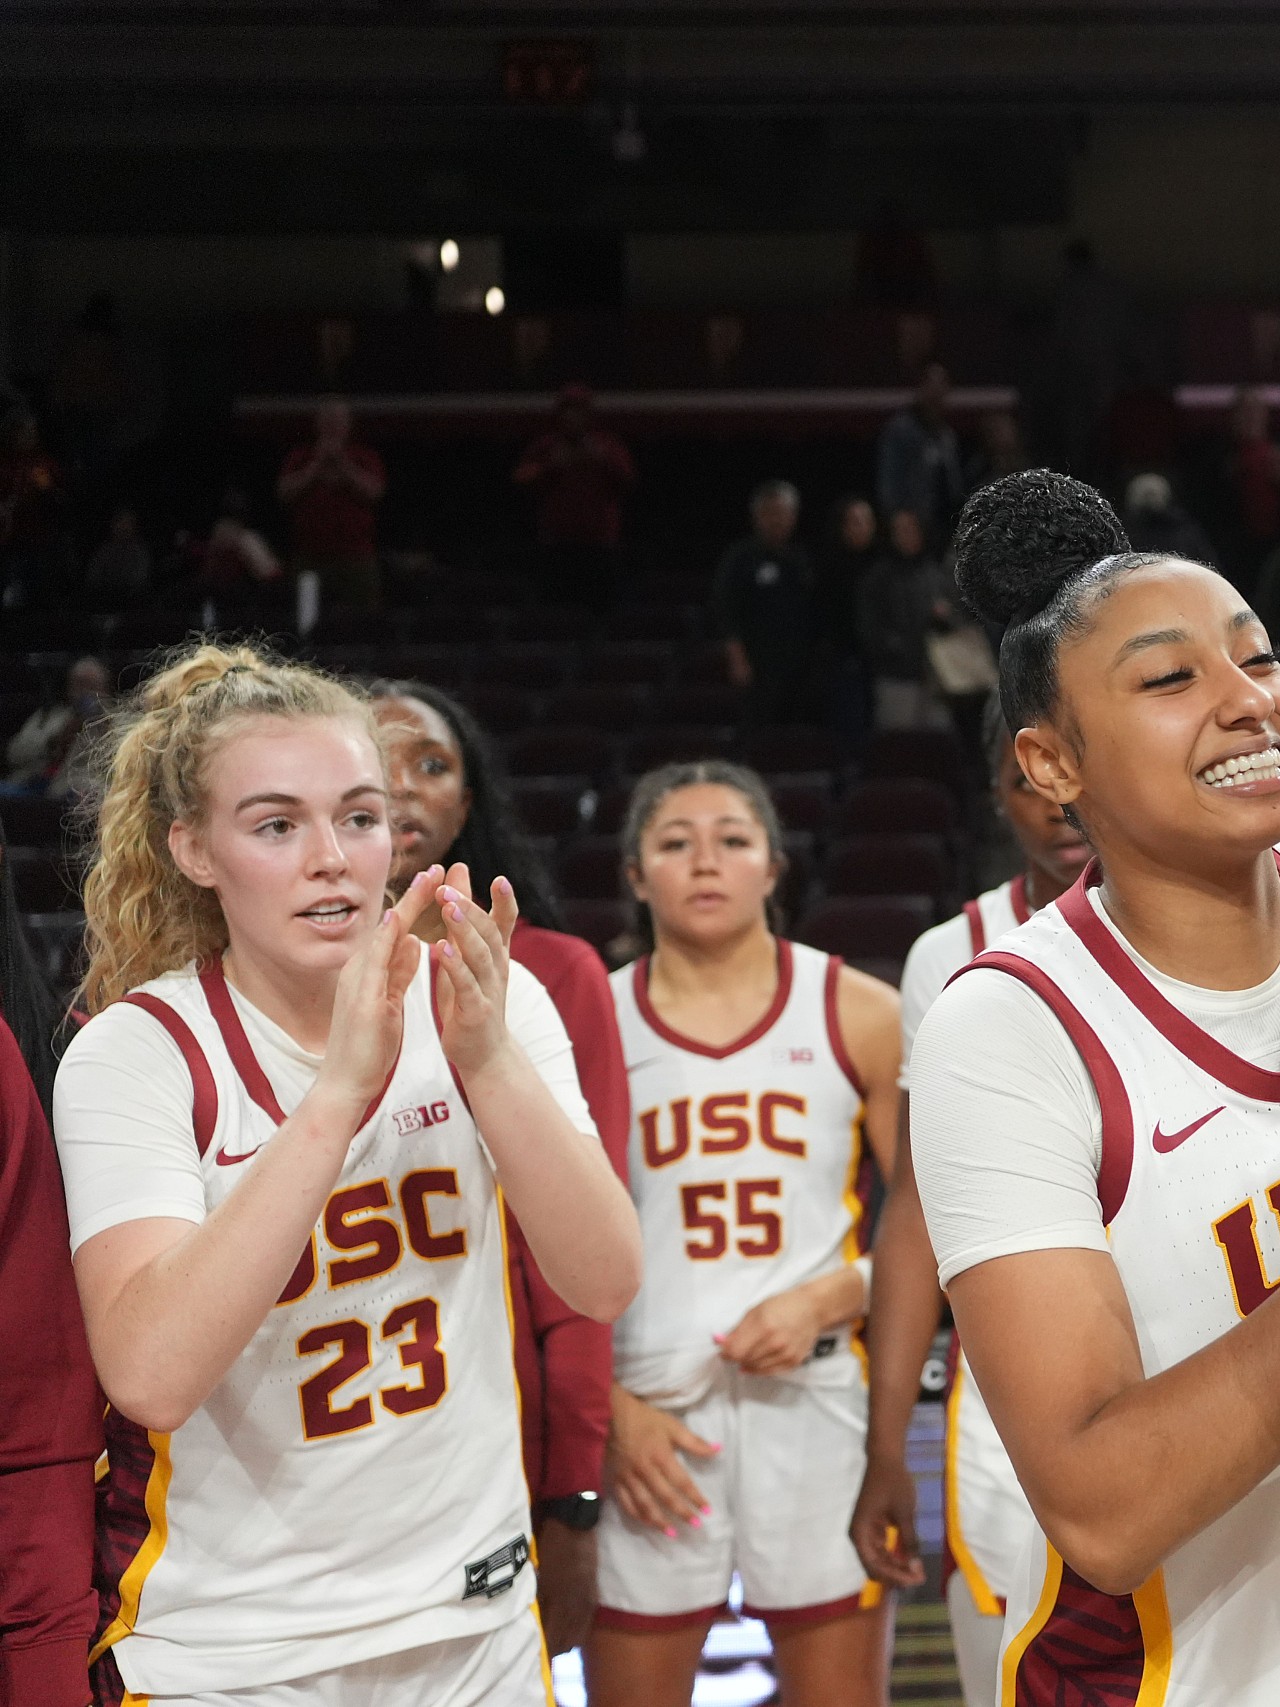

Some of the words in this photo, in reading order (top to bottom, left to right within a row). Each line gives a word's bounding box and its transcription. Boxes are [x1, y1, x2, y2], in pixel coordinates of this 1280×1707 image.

[639, 1090, 807, 1170] USC
[679, 1178, 783, 1261] 55
[295, 1296, 449, 1442] 23
